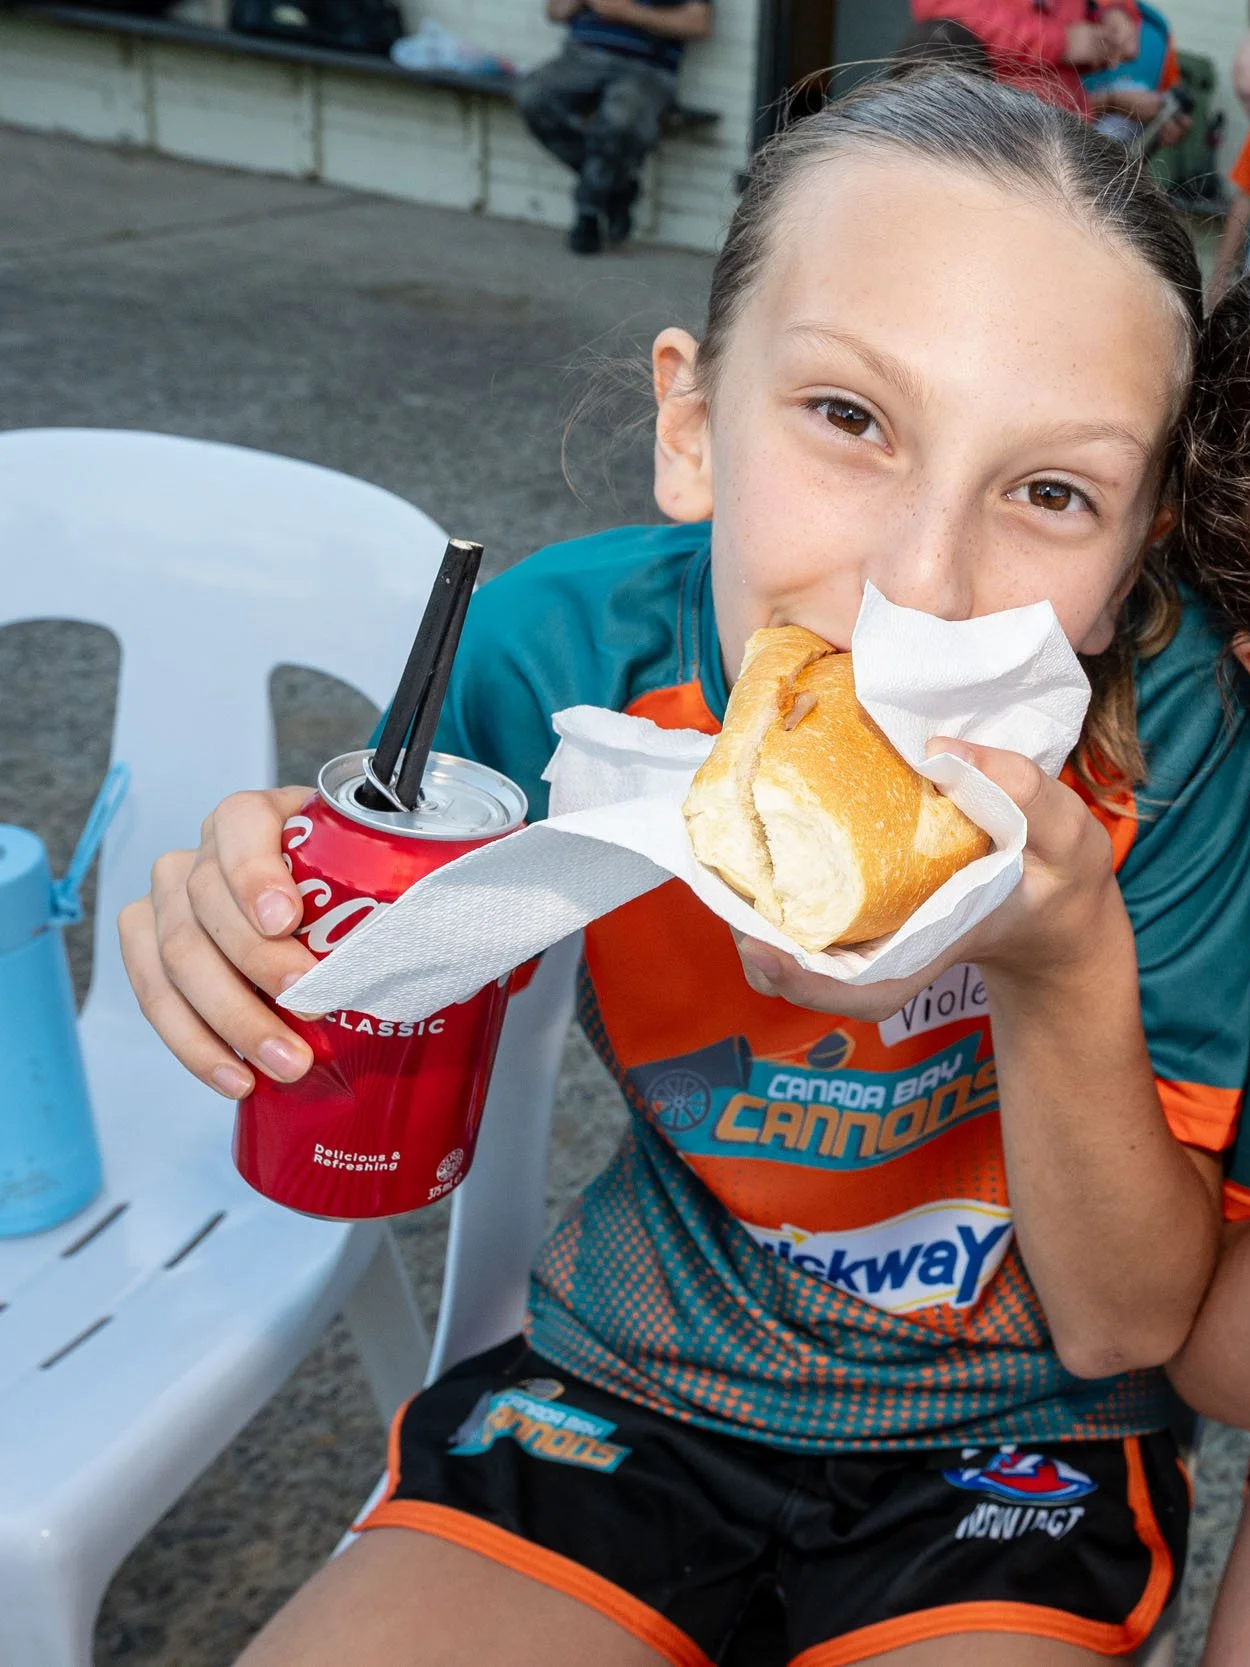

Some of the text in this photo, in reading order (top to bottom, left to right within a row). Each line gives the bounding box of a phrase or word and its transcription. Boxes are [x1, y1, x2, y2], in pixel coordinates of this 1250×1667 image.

[767, 1053, 963, 1109] CANADA BAY
[715, 1056, 1000, 1158] CANNONS
[313, 1153, 398, 1171] Refreshing
[314, 1143, 401, 1162] Delicious &
